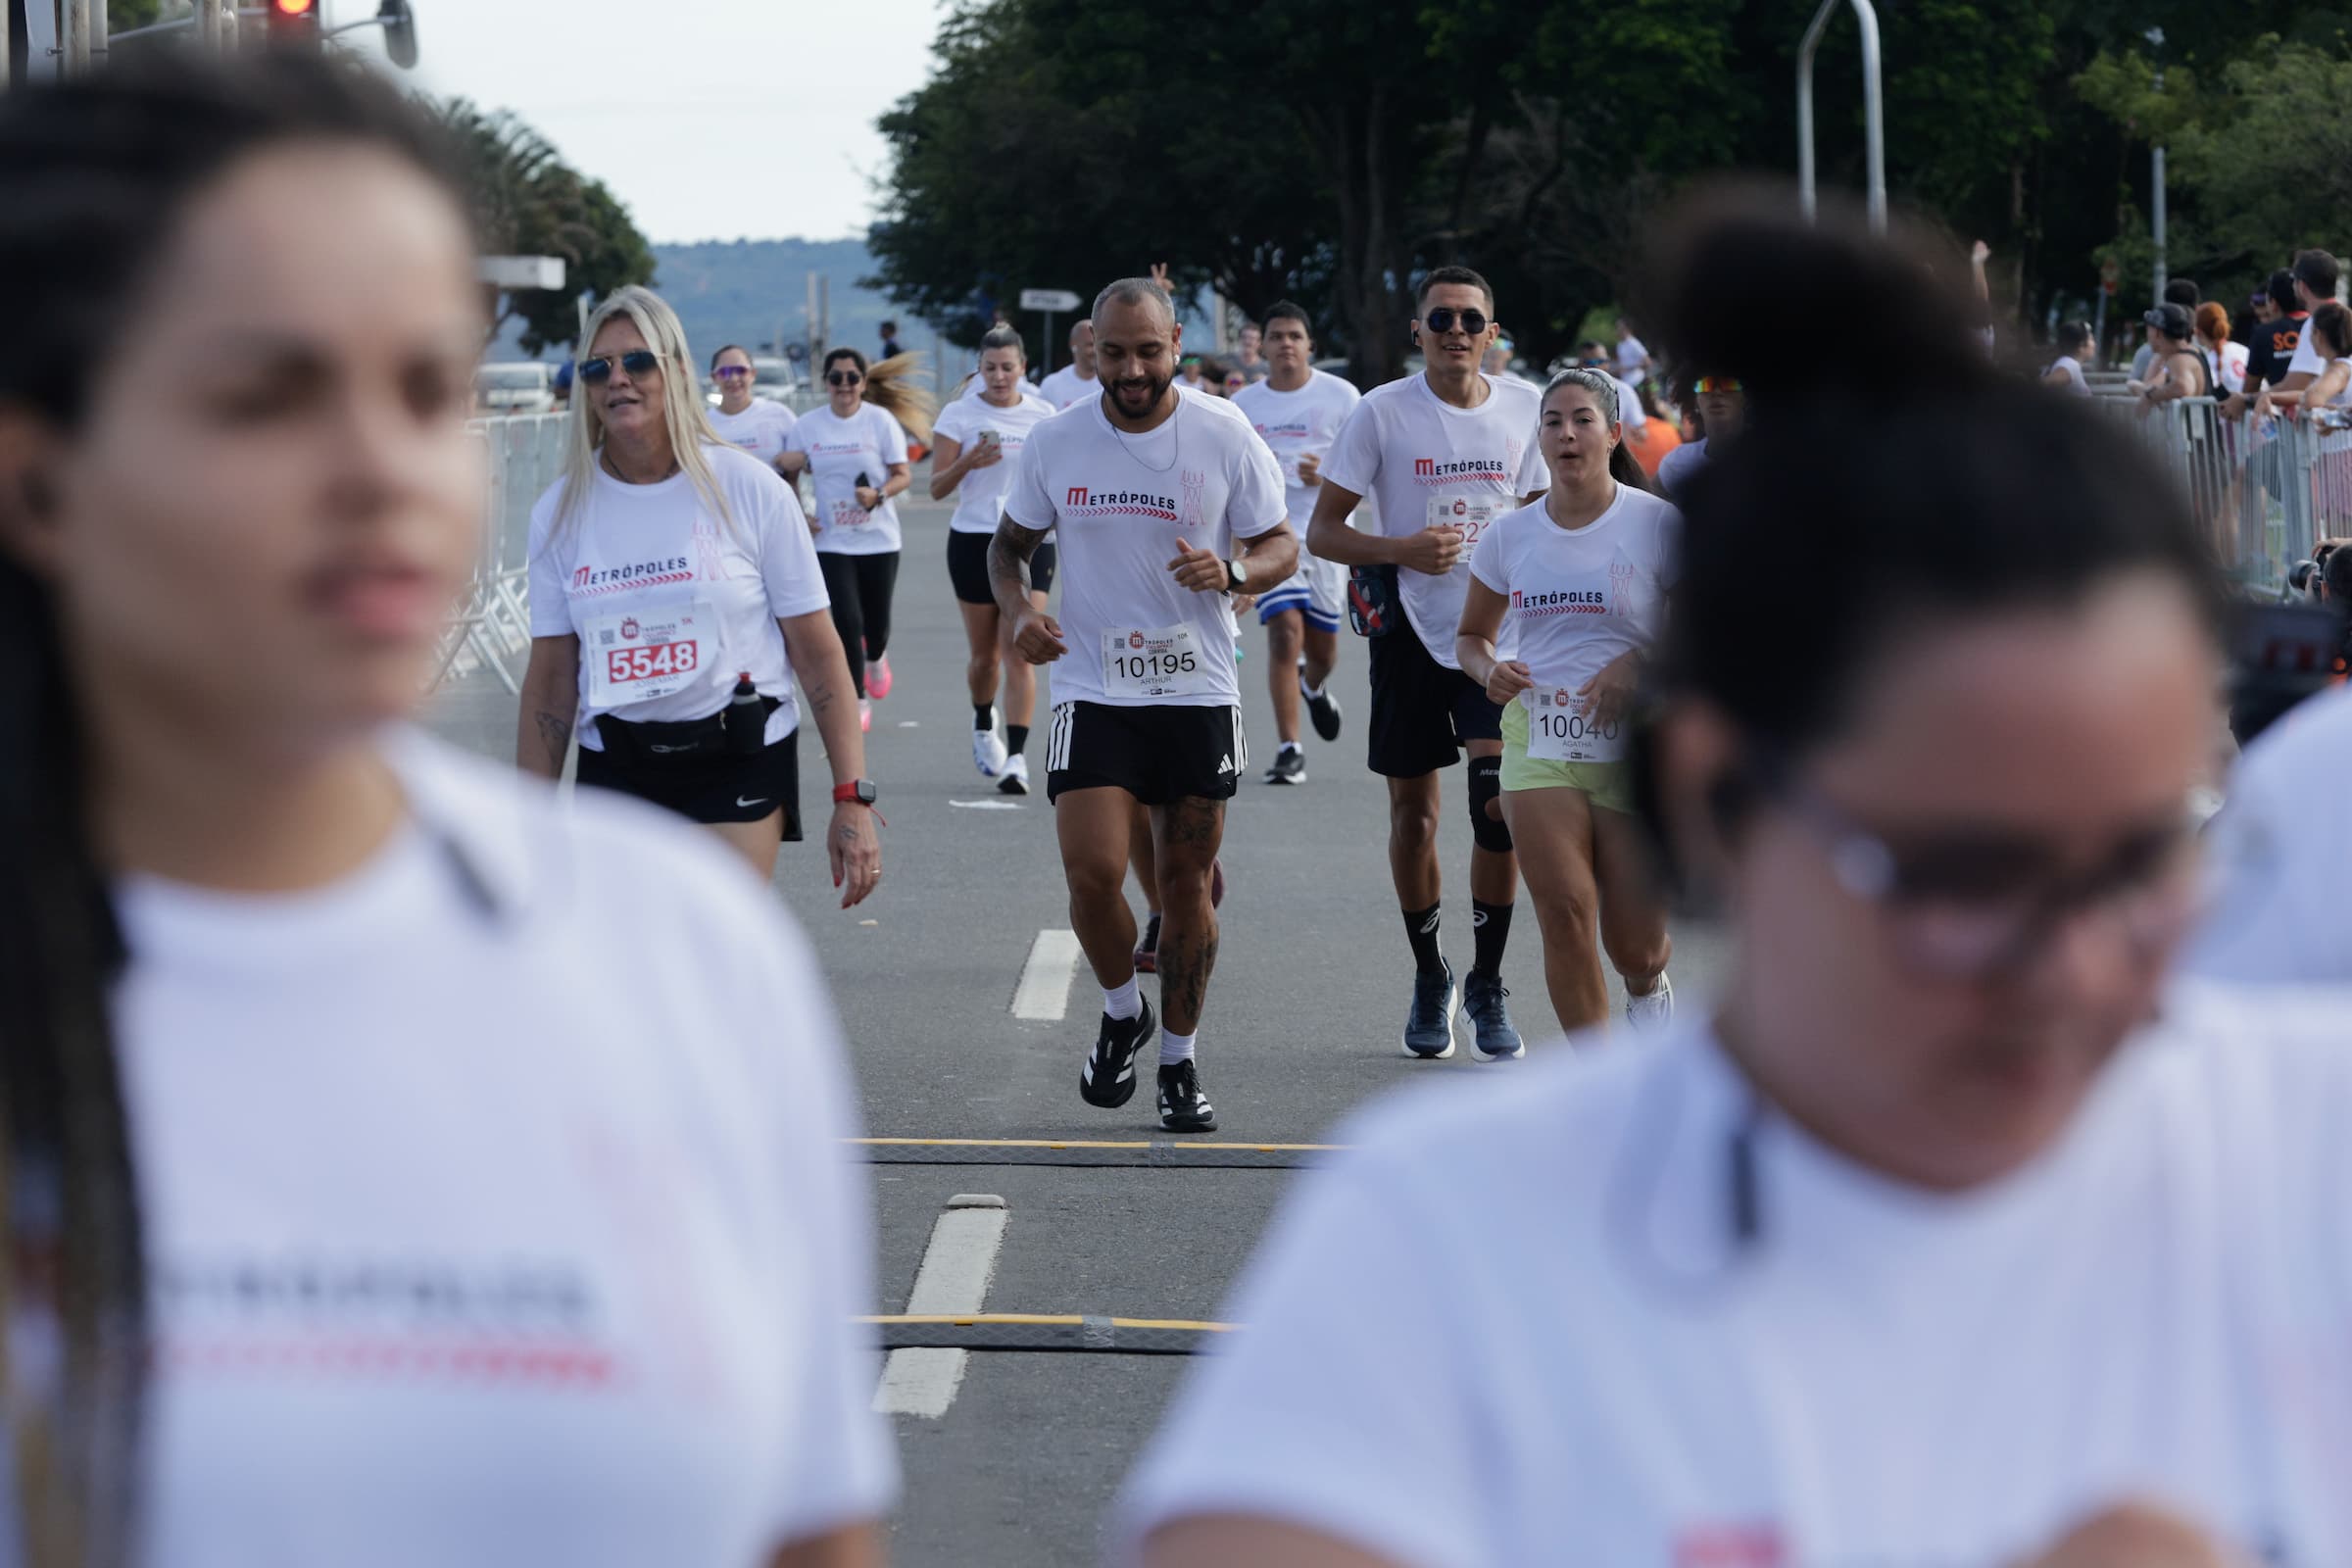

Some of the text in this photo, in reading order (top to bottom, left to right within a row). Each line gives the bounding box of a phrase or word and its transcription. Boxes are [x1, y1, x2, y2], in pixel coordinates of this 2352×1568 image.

[1415, 459, 1503, 476] METRÓPOLES
[1067, 487, 1175, 510] METRÓPOLES
[573, 557, 688, 588] METRÓPOLES
[1512, 590, 1603, 609] METRÓPOLES
[611, 644, 695, 681] 5548
[1114, 651, 1196, 678] 10195
[1140, 675, 1172, 686] ARTHUR
